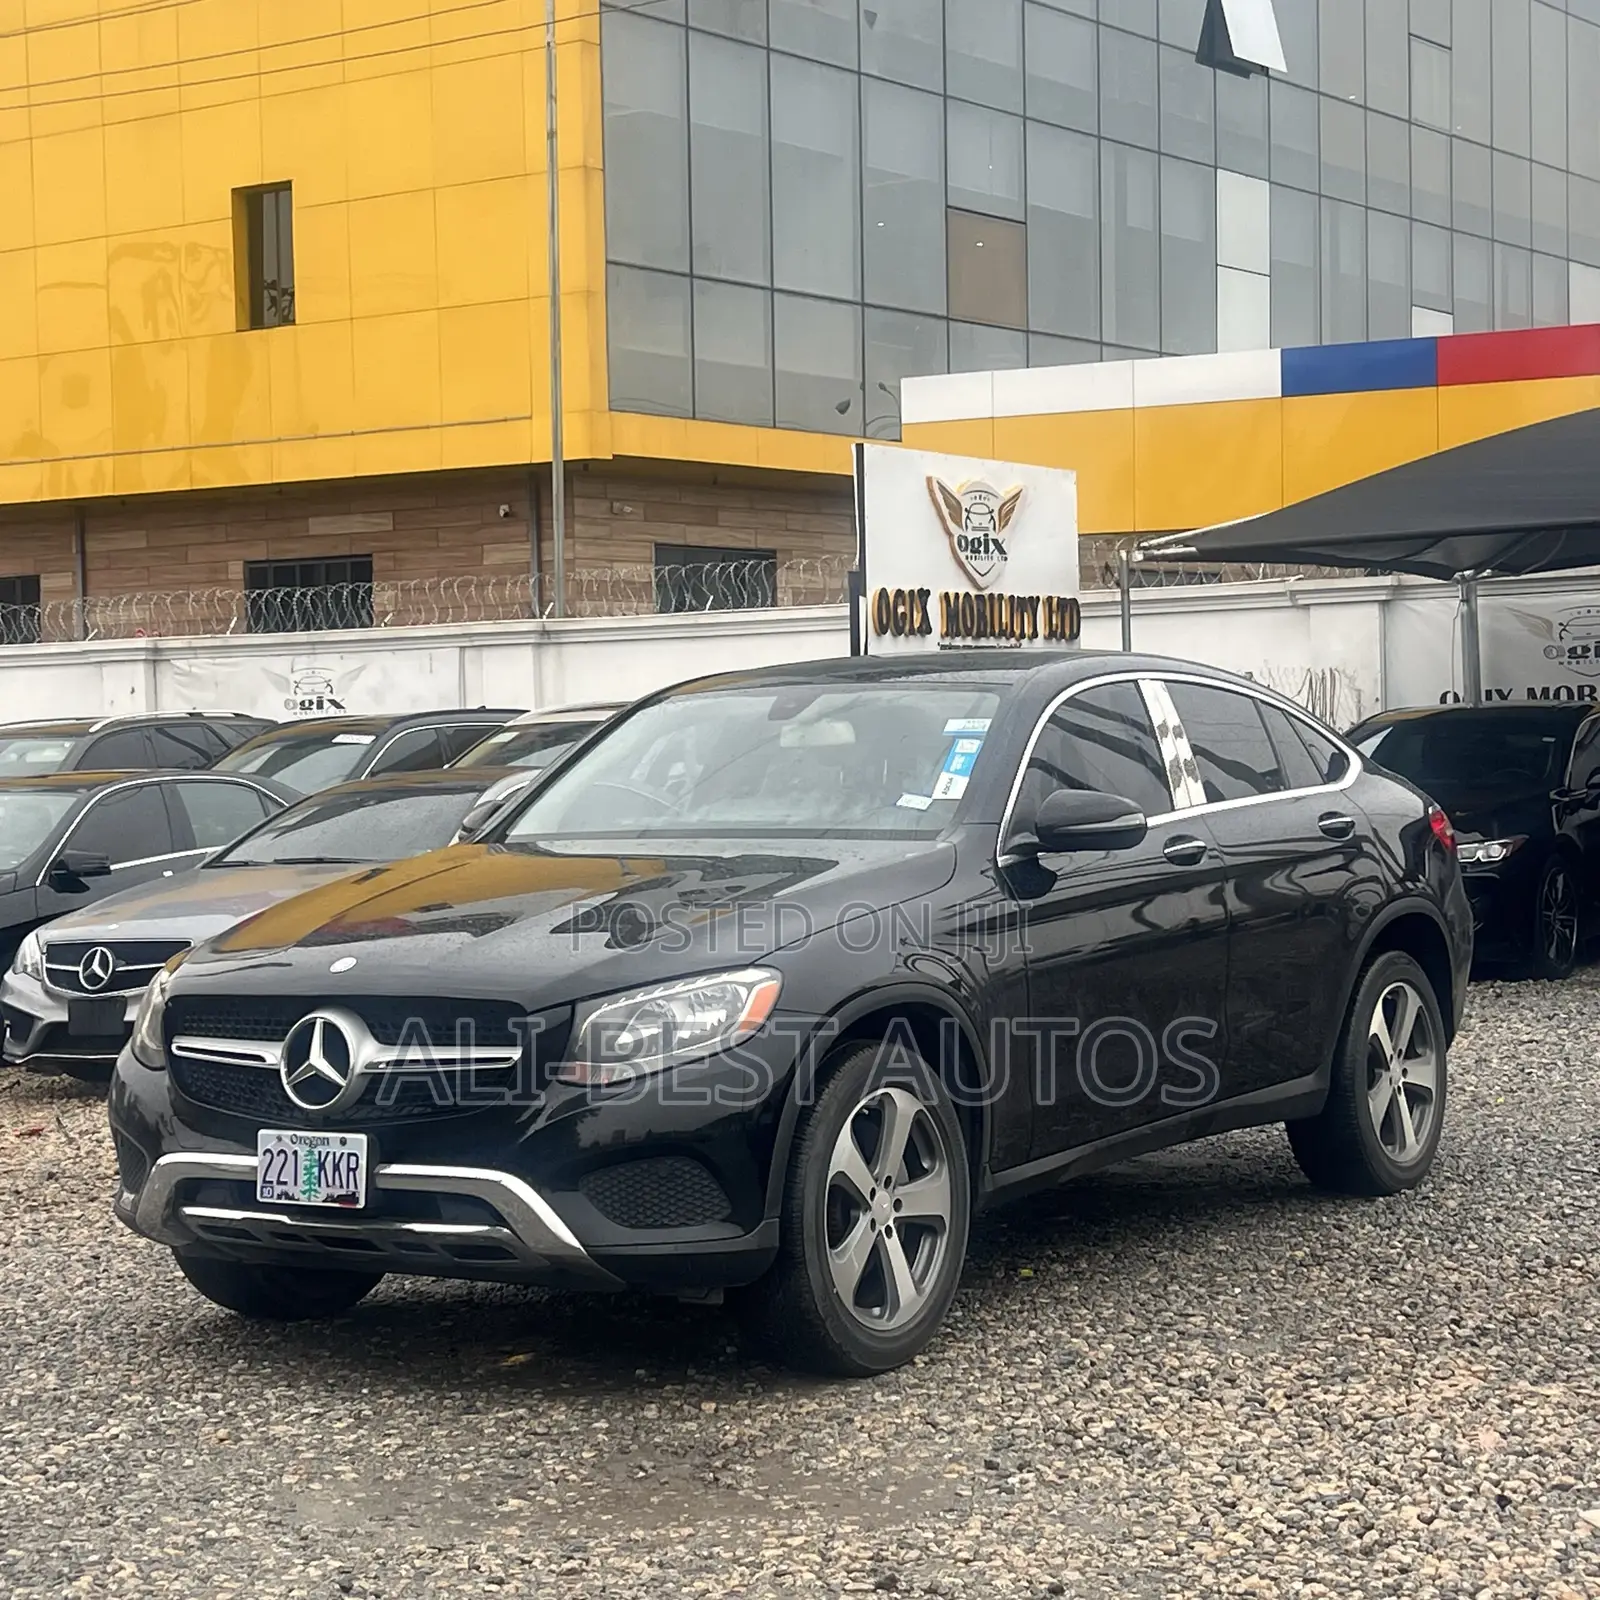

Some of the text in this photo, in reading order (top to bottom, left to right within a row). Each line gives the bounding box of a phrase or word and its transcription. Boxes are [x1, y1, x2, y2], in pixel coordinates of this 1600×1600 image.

[872, 587, 1081, 642] OGIX MOBILITY LTD
[1526, 684, 1600, 702] MOB
[290, 1133, 330, 1148] Oregon
[262, 1148, 359, 1190] 221 KKR
